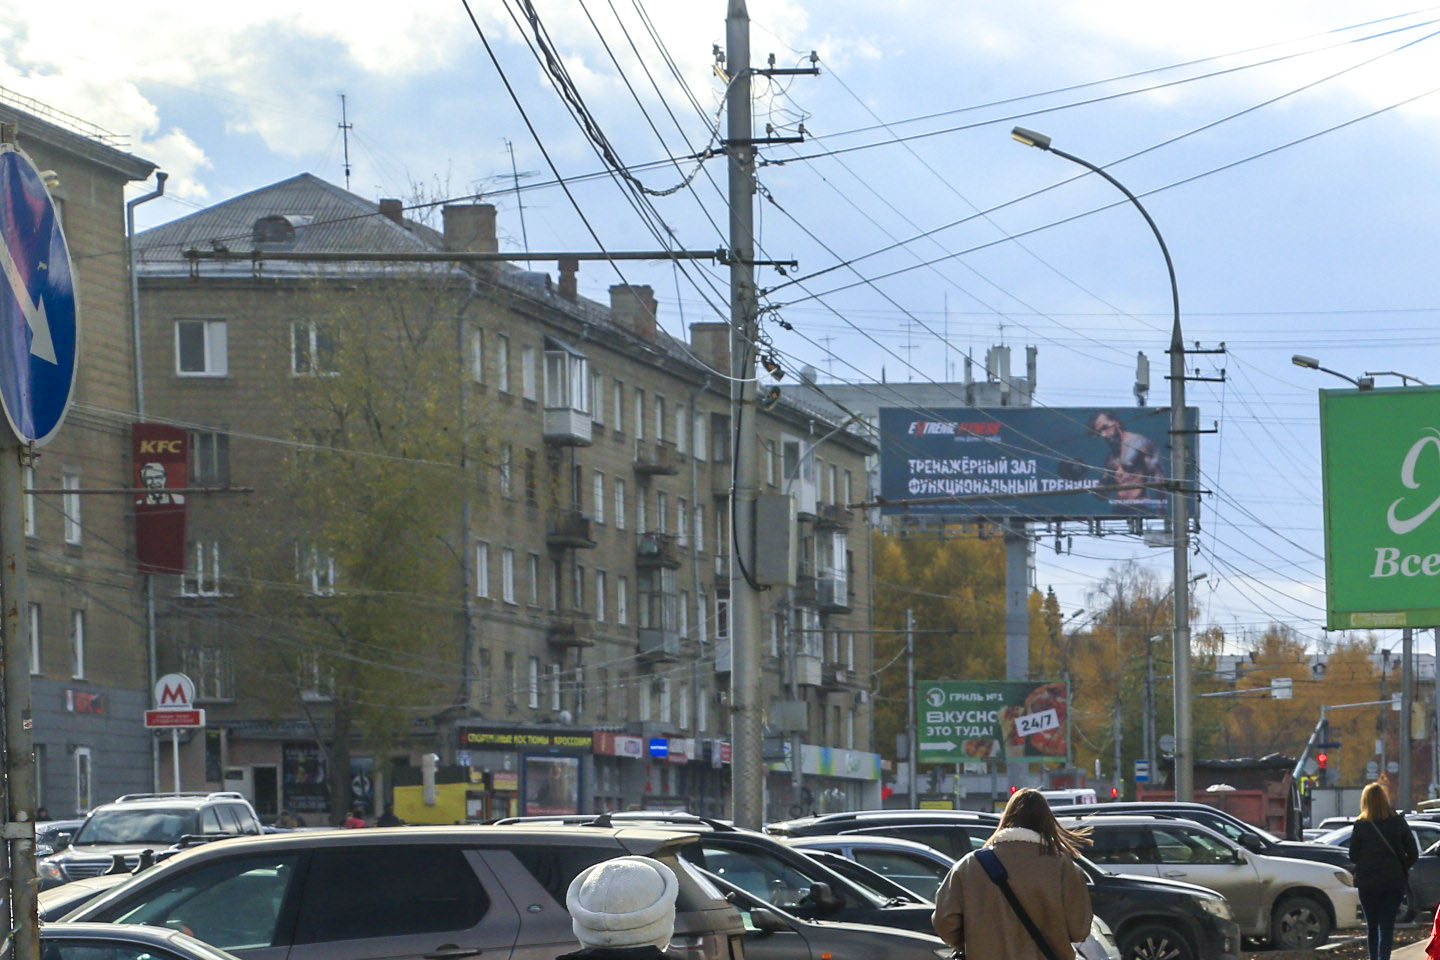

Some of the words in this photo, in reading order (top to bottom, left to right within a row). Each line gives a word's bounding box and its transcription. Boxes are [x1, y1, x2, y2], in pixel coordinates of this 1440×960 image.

[908, 420, 959, 437] EXTREME
[140, 440, 182, 454] KFC
[908, 456, 1008, 474] ТРЕНАЖЁРНЫЙ
[1010, 459, 1037, 474] ЗАЛ
[908, 475, 1038, 495] ФУНКЦИОНАЛЬНЫЙ
[161, 683, 187, 704] М
[950, 693, 984, 702] ГРИЛЬ
[926, 726, 952, 736] ЭТО
[954, 726, 994, 737] ТУДА!
[1021, 714, 1053, 732] 24/7
